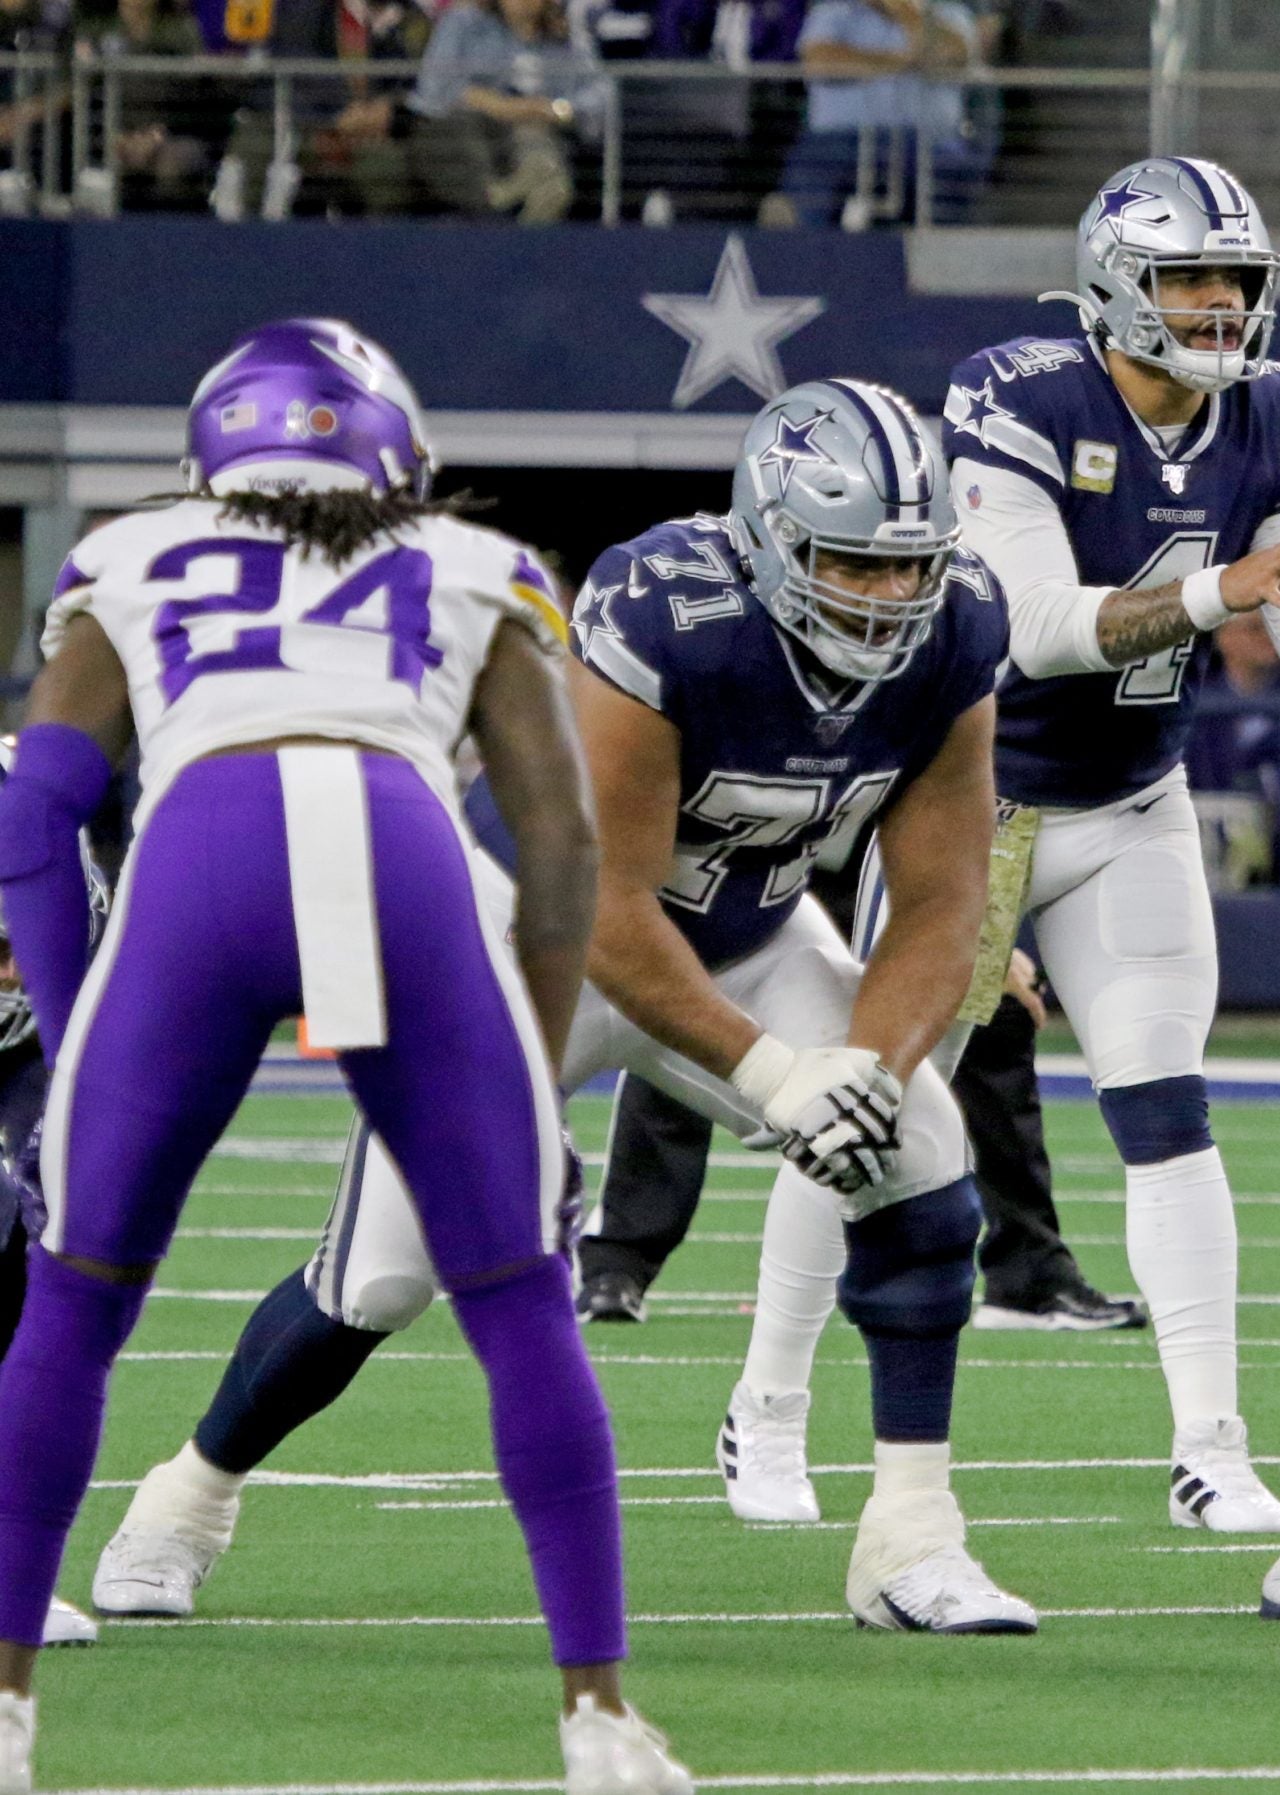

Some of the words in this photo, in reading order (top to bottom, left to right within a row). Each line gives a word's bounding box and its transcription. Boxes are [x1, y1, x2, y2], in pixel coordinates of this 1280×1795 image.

[1006, 341, 1084, 378] 4
[1076, 444, 1116, 481] C
[1147, 507, 1206, 523] COWBOYS
[642, 541, 744, 631] 71
[142, 536, 443, 707] 24
[657, 768, 900, 914] 71
